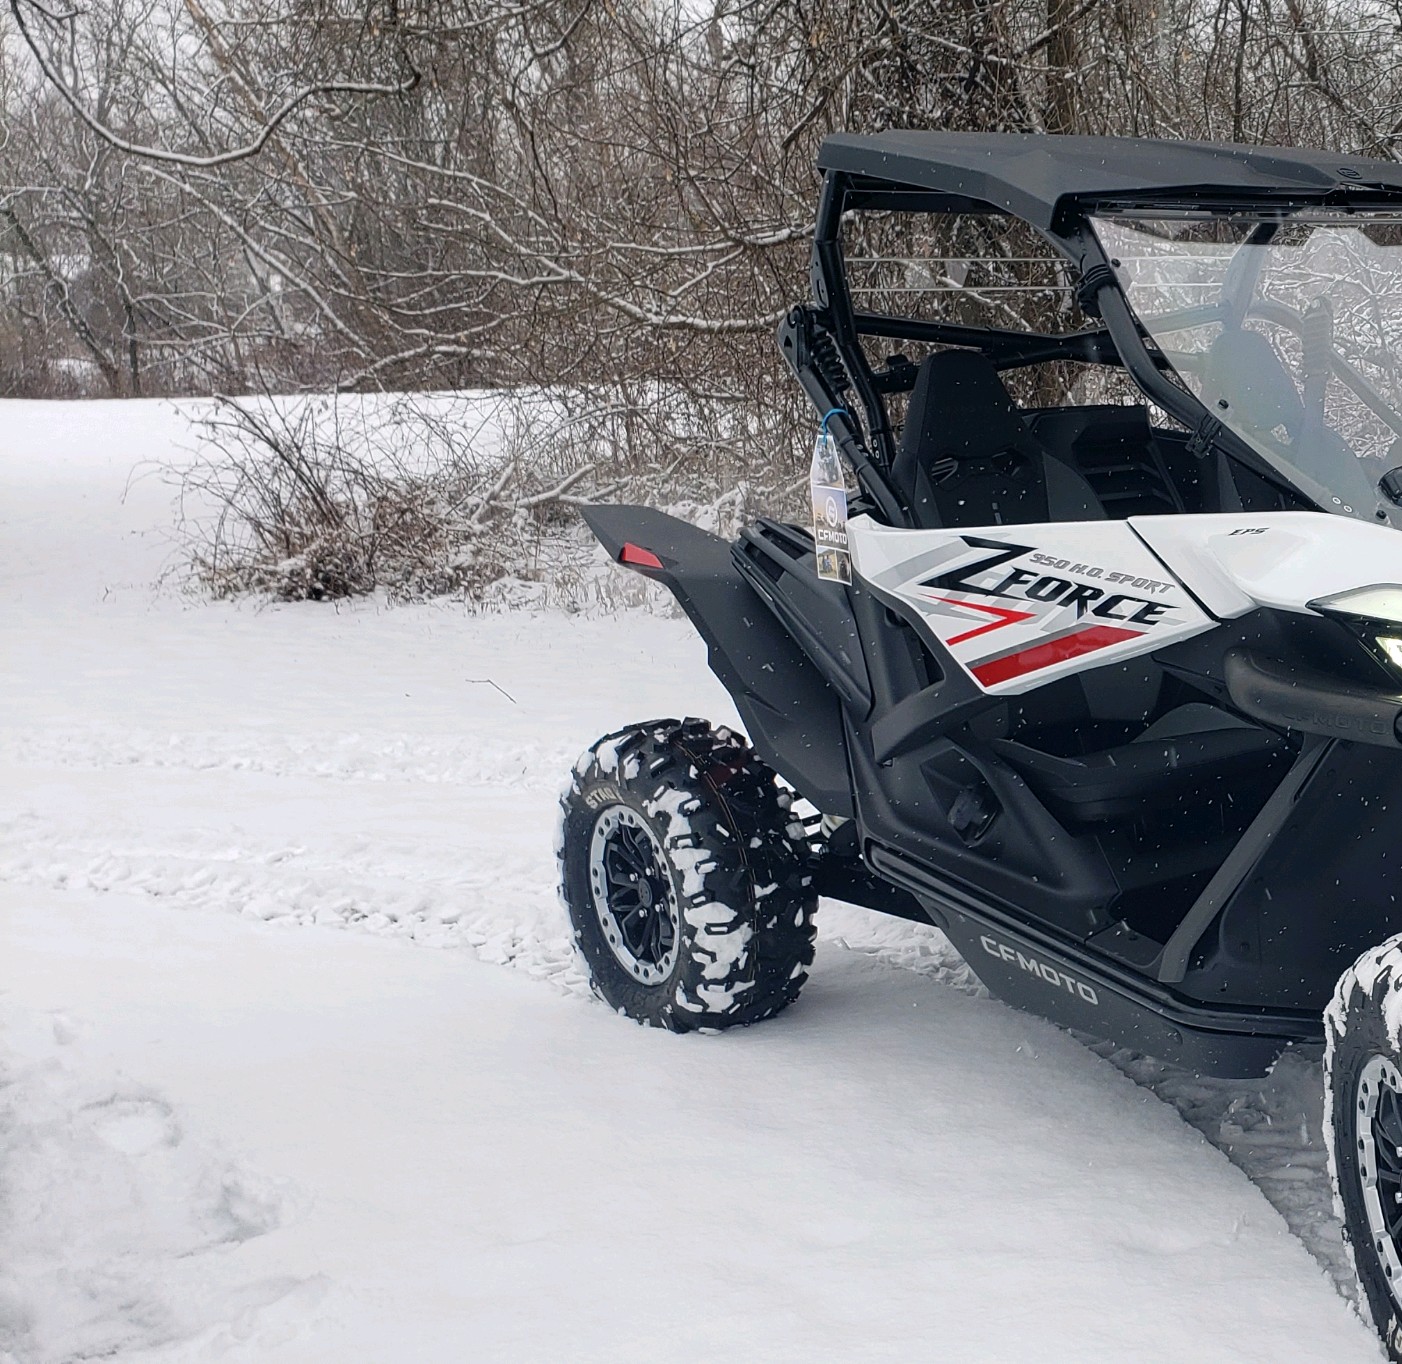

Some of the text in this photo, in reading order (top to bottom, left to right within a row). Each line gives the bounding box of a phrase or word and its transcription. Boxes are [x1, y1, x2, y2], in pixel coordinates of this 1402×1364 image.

[817, 529, 848, 545] CFMOTO
[1228, 527, 1270, 536] EPS
[1029, 553, 1071, 571] 950
[1105, 572, 1176, 595] SPORT
[980, 935, 1099, 1005] CFMOTO
